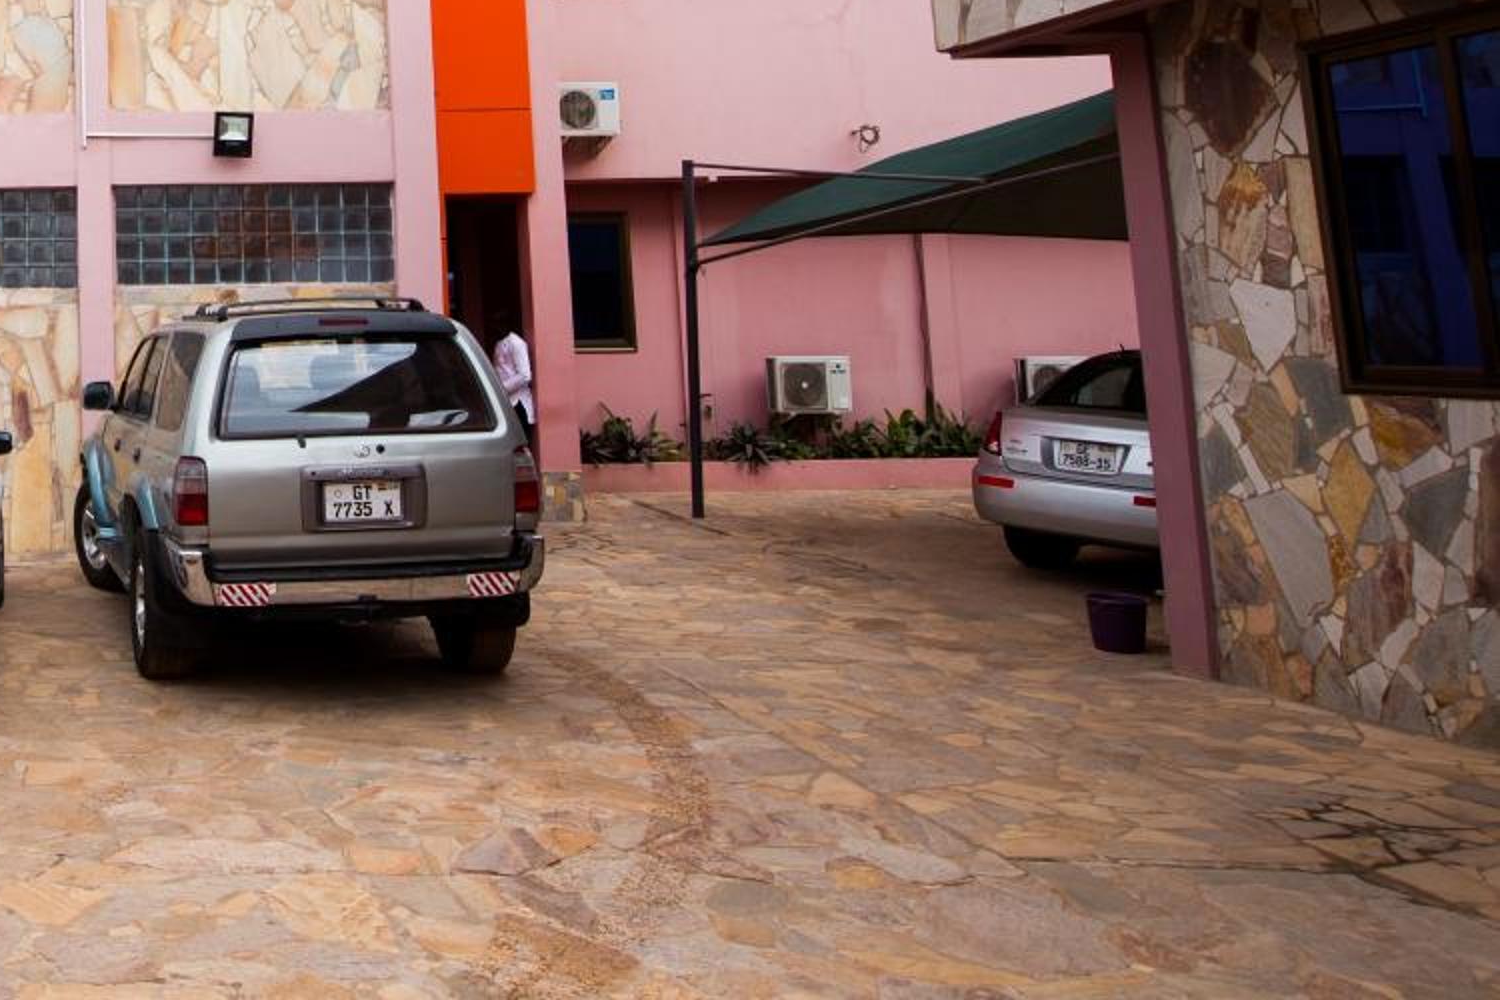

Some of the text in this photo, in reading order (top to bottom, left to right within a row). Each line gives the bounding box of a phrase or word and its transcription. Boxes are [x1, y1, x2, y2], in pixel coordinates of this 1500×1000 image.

[353, 485, 372, 500] GT
[333, 499, 393, 518] 7735 X
